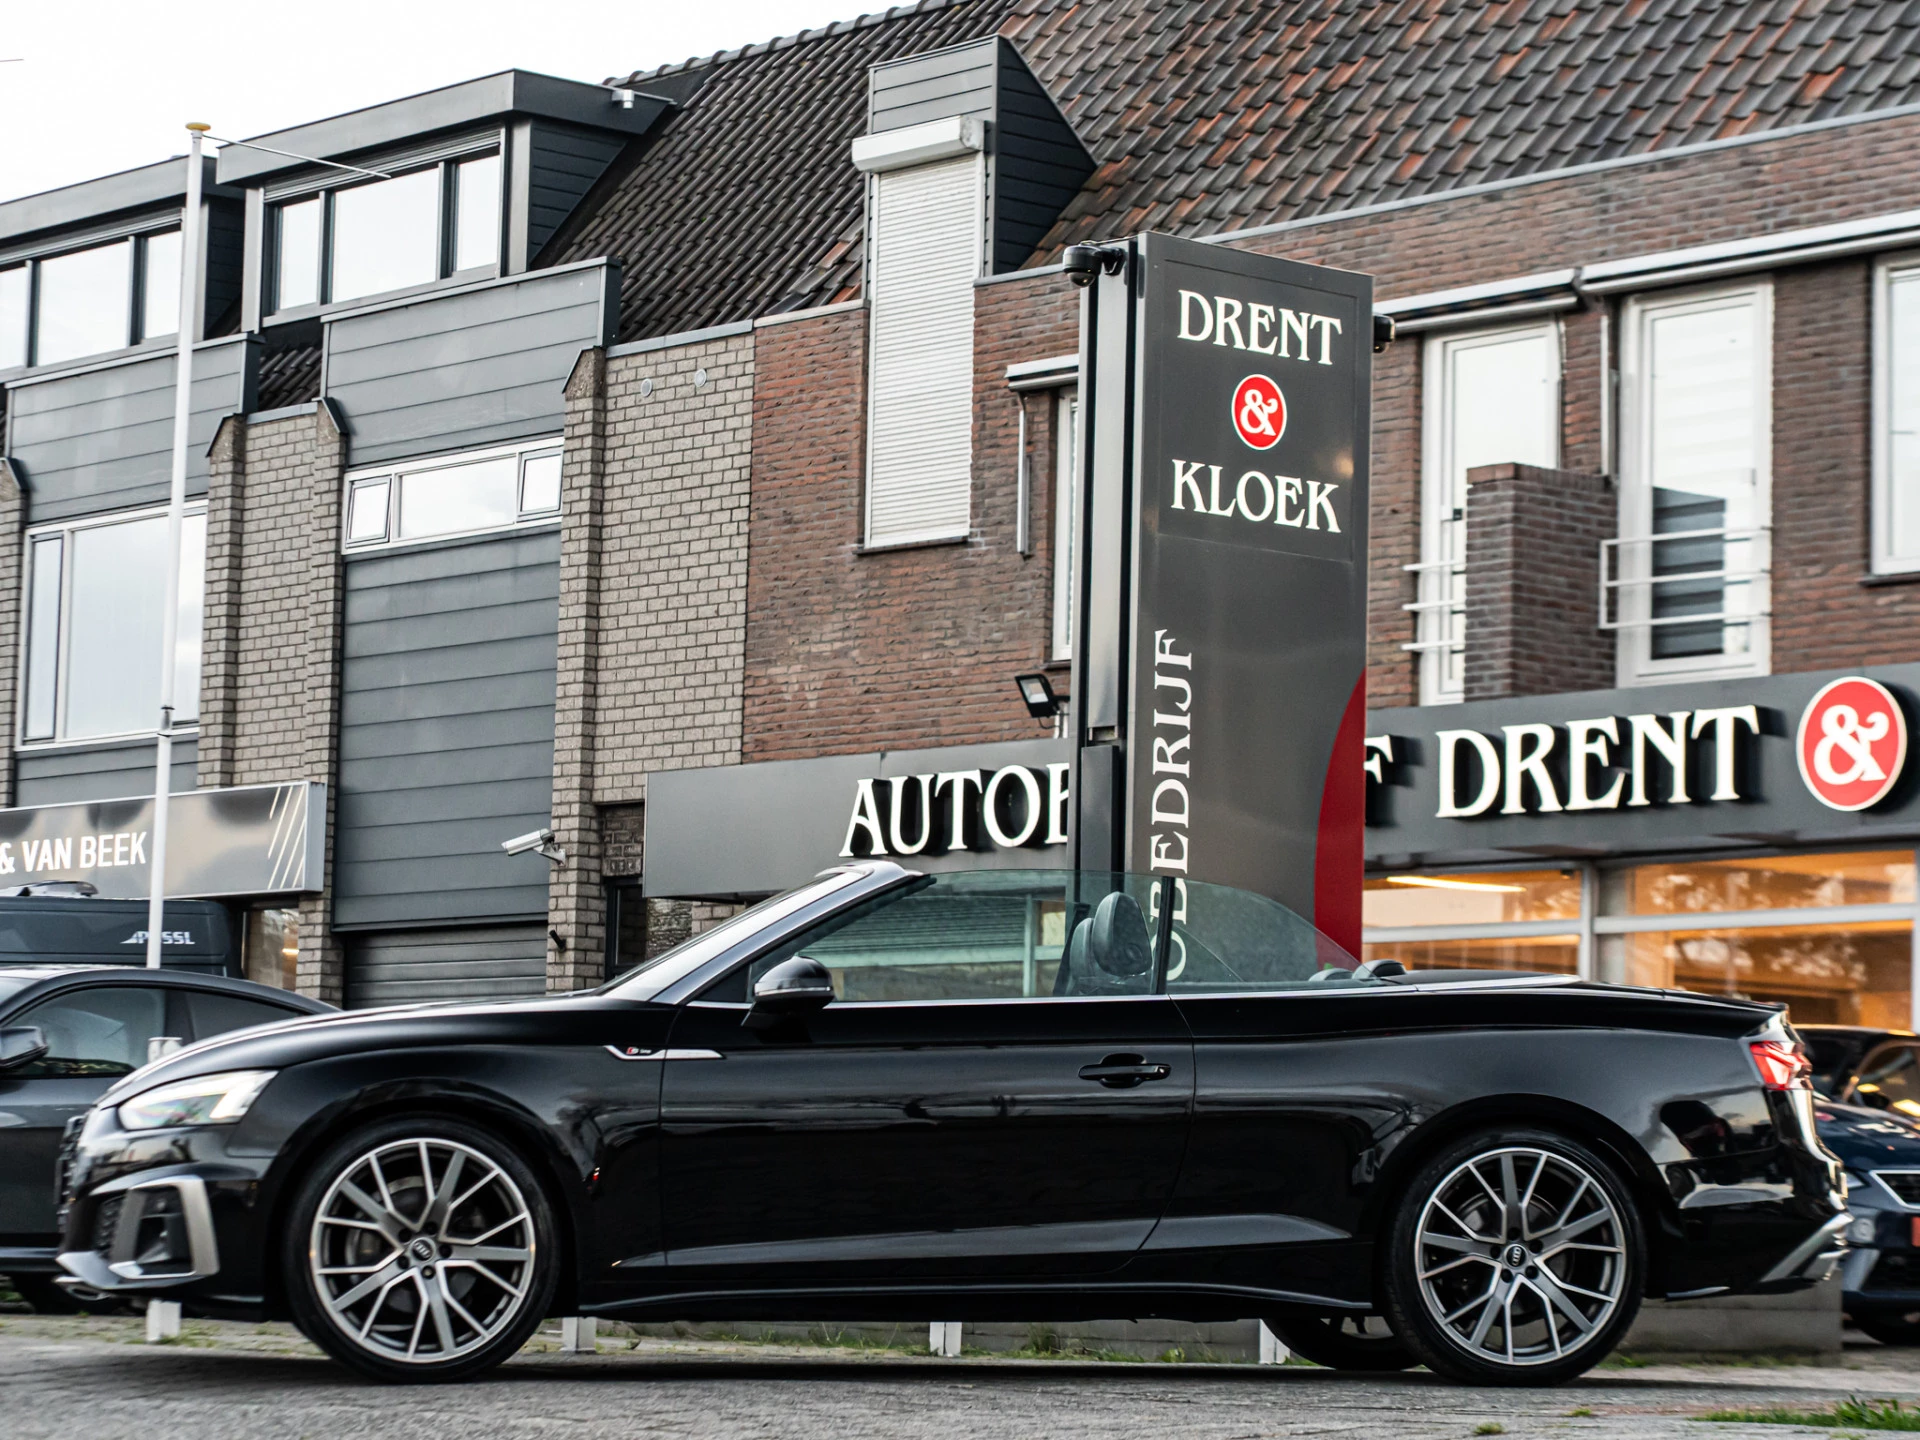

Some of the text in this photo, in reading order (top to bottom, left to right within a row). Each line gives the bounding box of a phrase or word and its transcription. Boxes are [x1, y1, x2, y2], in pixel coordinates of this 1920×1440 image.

[1177, 289, 1343, 366] DRENT
[1240, 388, 1278, 437] &
[1171, 458, 1342, 534] KLOEK
[1434, 704, 1760, 819] DRENT
[1812, 703, 1889, 786] &
[21, 837, 73, 873] VAN
[79, 831, 147, 869] BEEK
